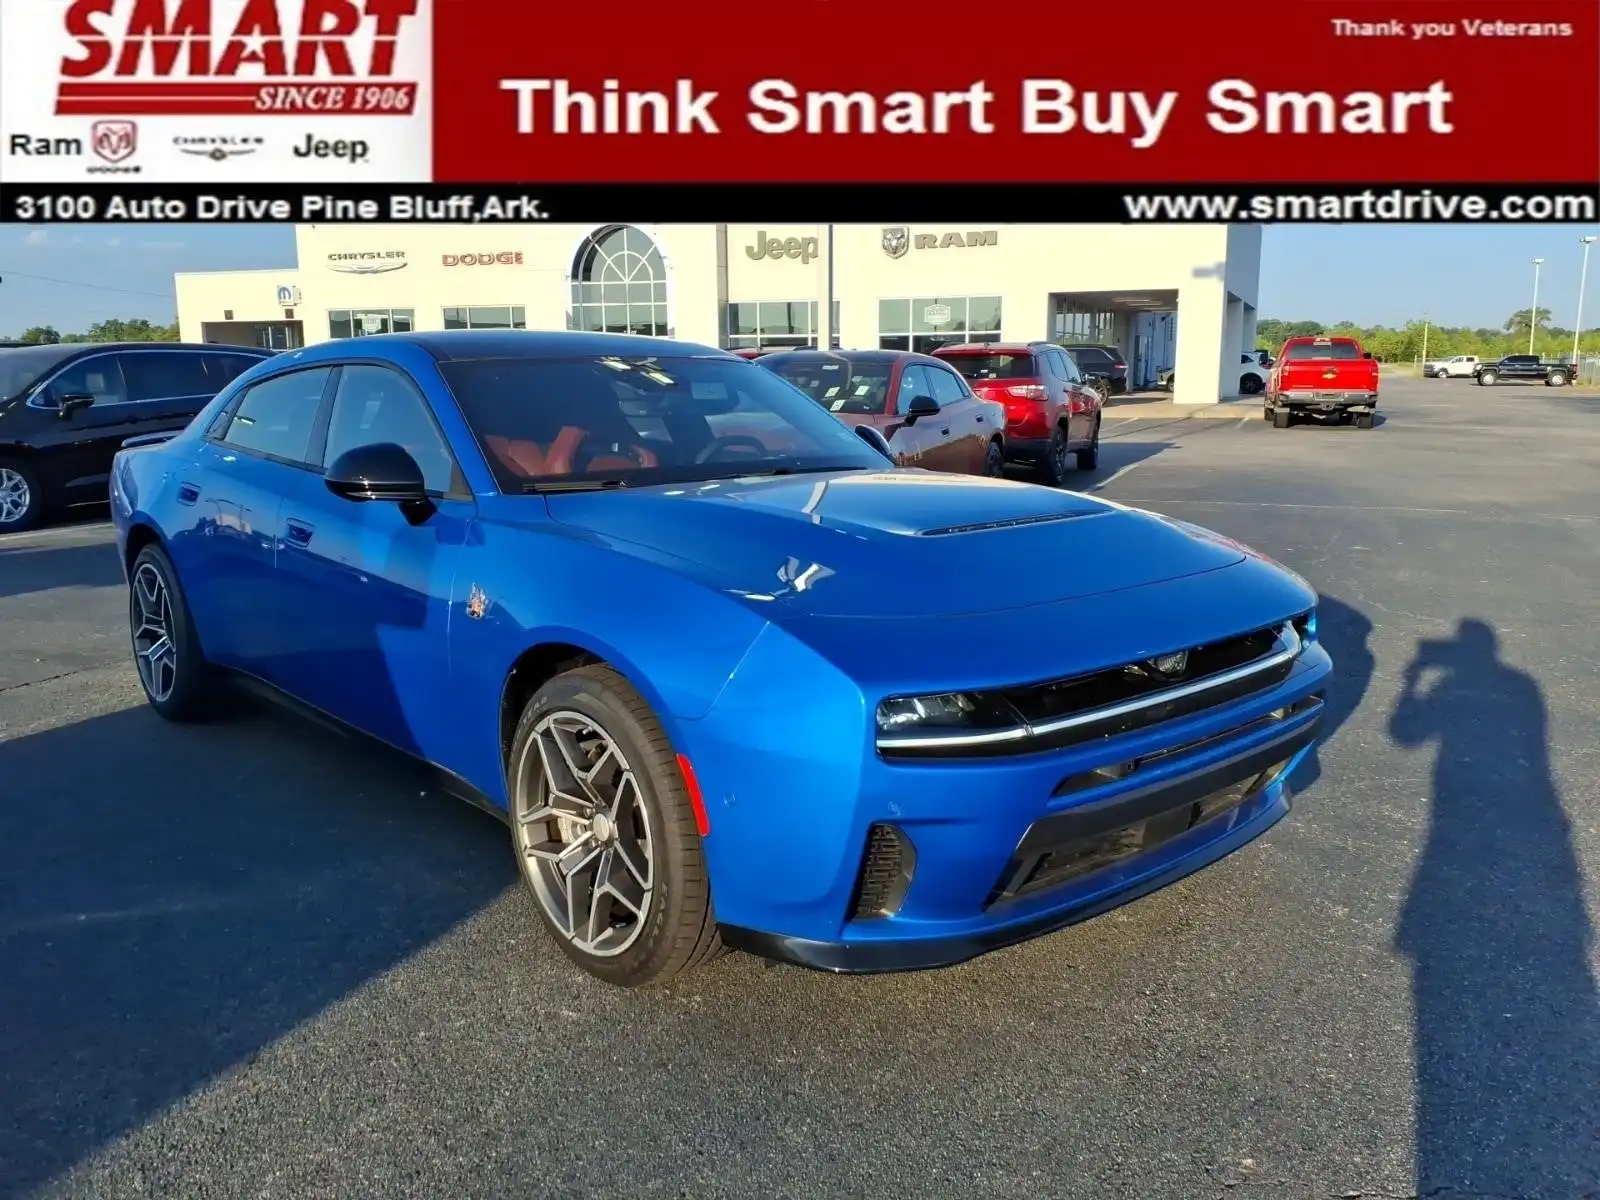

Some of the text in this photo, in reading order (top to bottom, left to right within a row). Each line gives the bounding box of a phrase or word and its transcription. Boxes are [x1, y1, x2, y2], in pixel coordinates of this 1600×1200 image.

[744, 230, 819, 264] Jeep
[914, 231, 998, 249] RAM
[327, 250, 406, 262] CHRYSLER
[441, 251, 524, 267] DODGE
